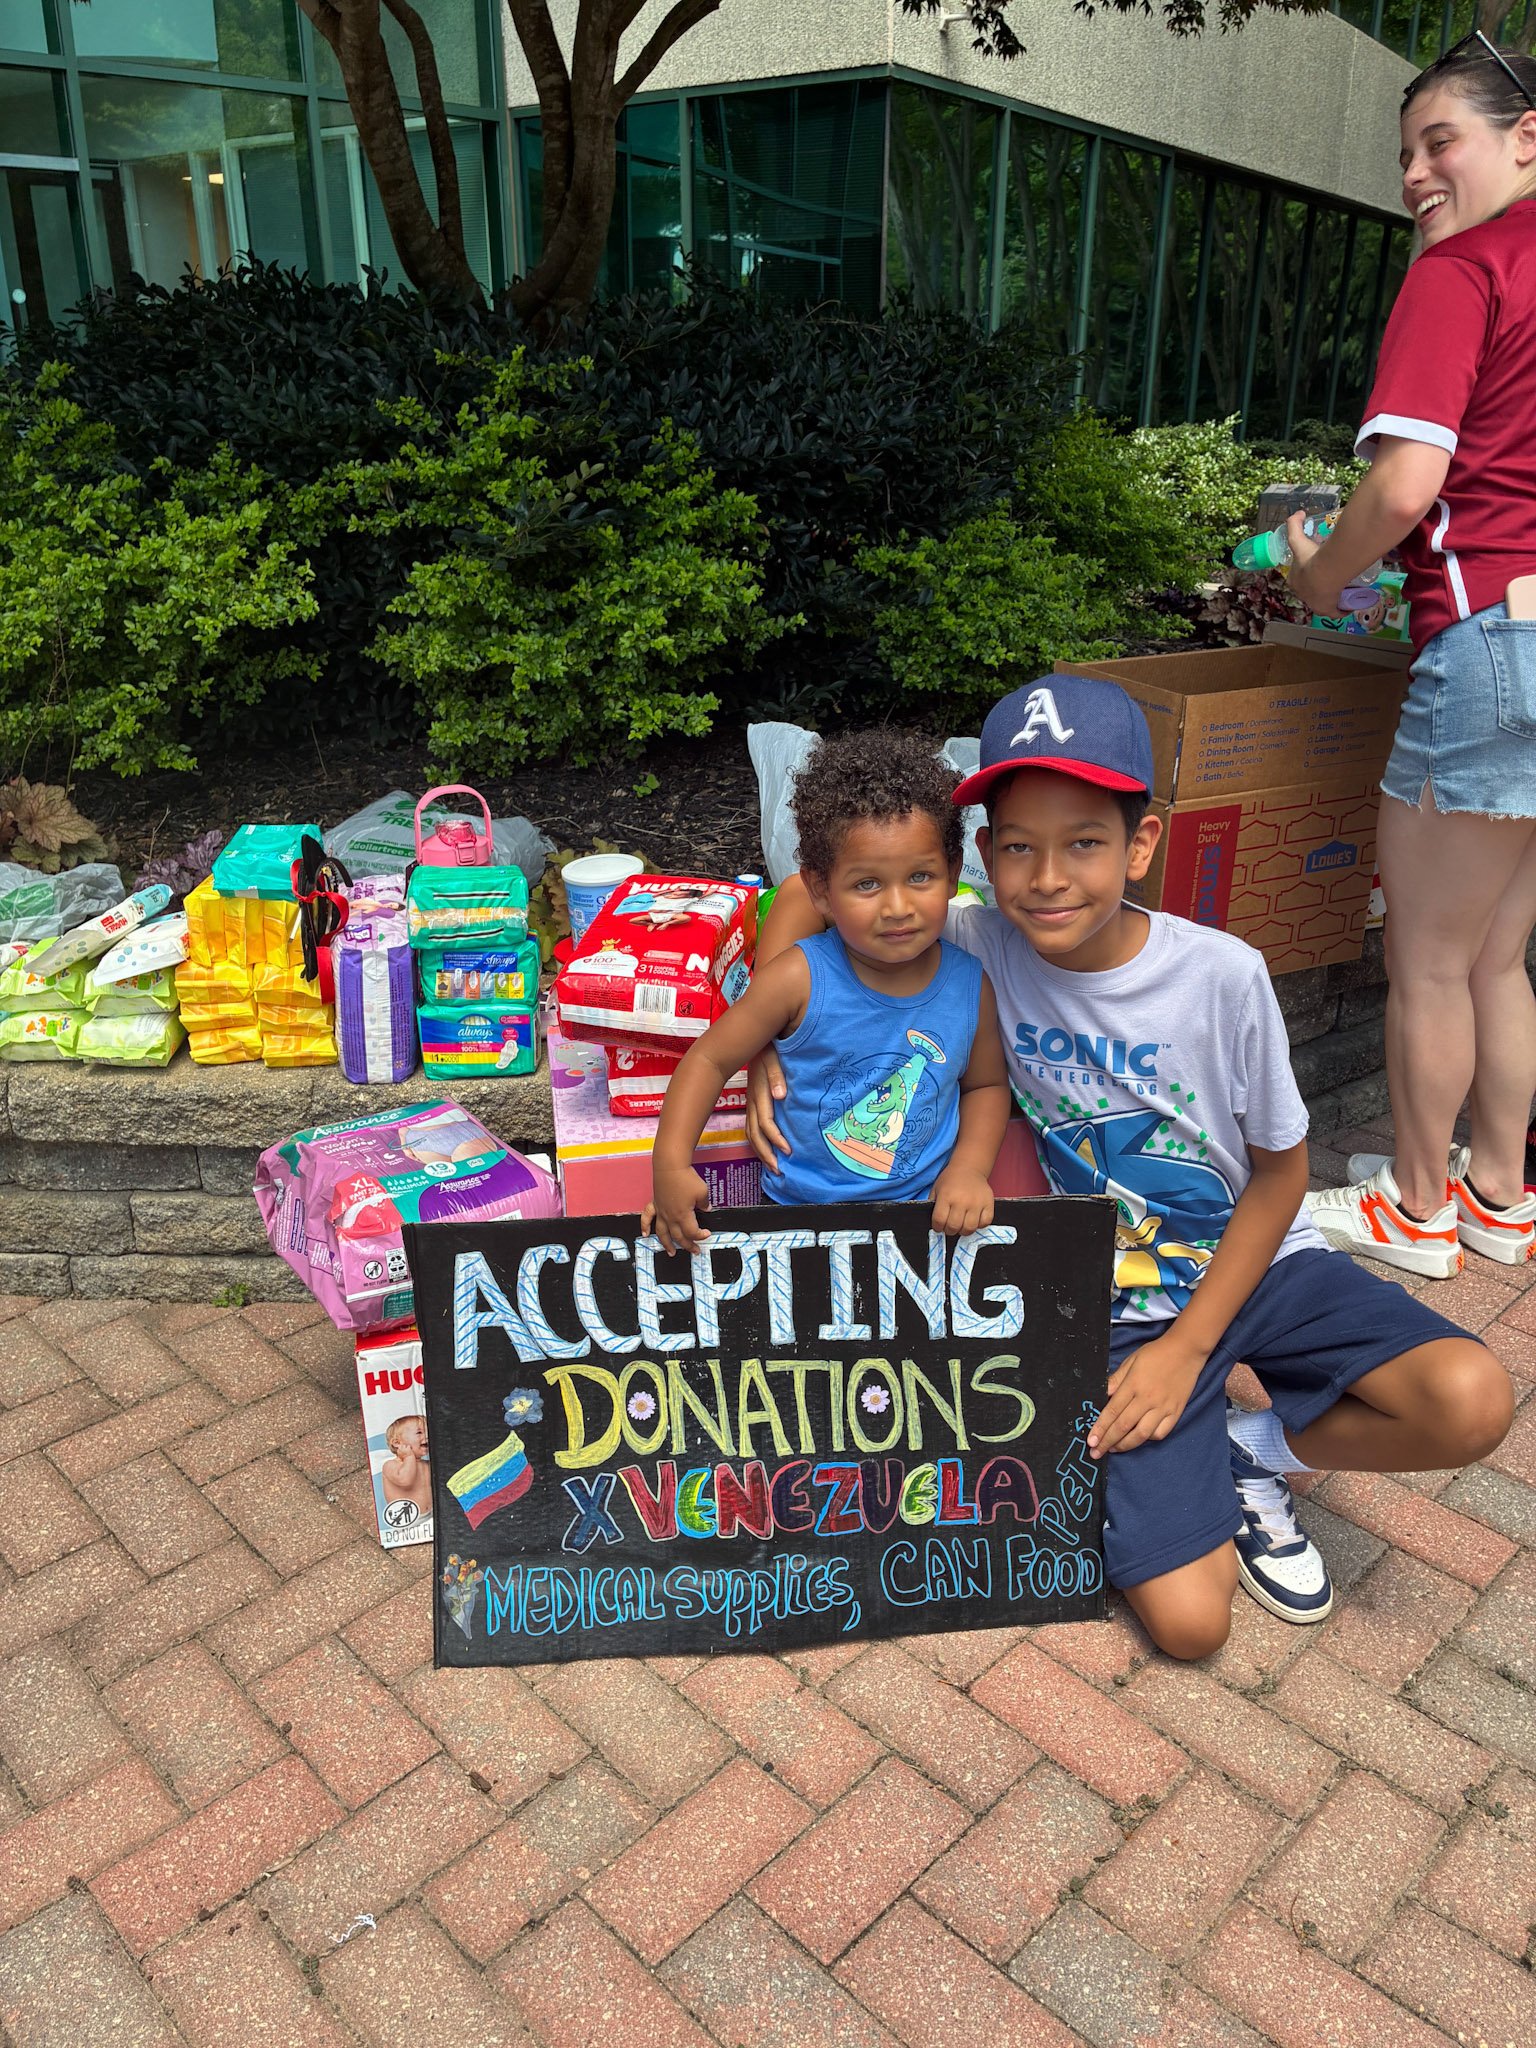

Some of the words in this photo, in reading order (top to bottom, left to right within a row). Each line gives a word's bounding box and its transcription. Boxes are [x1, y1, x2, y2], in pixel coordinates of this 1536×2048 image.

[1276, 697, 1308, 708] FRAGILE
[1009, 687, 1076, 748] A
[1210, 721, 1244, 732] Bedroom
[1208, 734, 1233, 745] Family
[1234, 732, 1256, 741] Room
[1206, 747, 1231, 758] Dining
[1232, 745, 1254, 753] Room
[1205, 759, 1234, 769] Kitchen
[1203, 772, 1222, 782] Bath
[1199, 820, 1231, 833] Heavy
[1197, 834, 1222, 845] Duty
[1311, 849, 1353, 869] LOWE'S
[628, 882, 750, 903] HUGGIES
[485, 954, 516, 968] always
[685, 953, 710, 973] N
[714, 926, 745, 986] HUGGIES
[637, 964, 654, 973] 31
[457, 1025, 494, 1039] always
[1013, 1022, 1160, 1076] SONIC
[616, 1048, 635, 1071] 2
[1017, 1059, 1045, 1079] THE
[312, 1111, 400, 1140] Assurance
[428, 1162, 448, 1173] 19
[350, 1177, 374, 1192] XL
[454, 1225, 1025, 1370] ACCEPTING
[542, 1354, 1036, 1470] DONATIONS
[1034, 1436, 1099, 1547] PET
[560, 1472, 624, 1555] X
[617, 1456, 1041, 1543] VENEZUELA
[386, 1531, 399, 1543] DO
[401, 1526, 421, 1541] NOT
[482, 1563, 668, 1637] MEDICAL
[880, 1536, 992, 1607] CAN
[1005, 1533, 1104, 1601] FOOD
